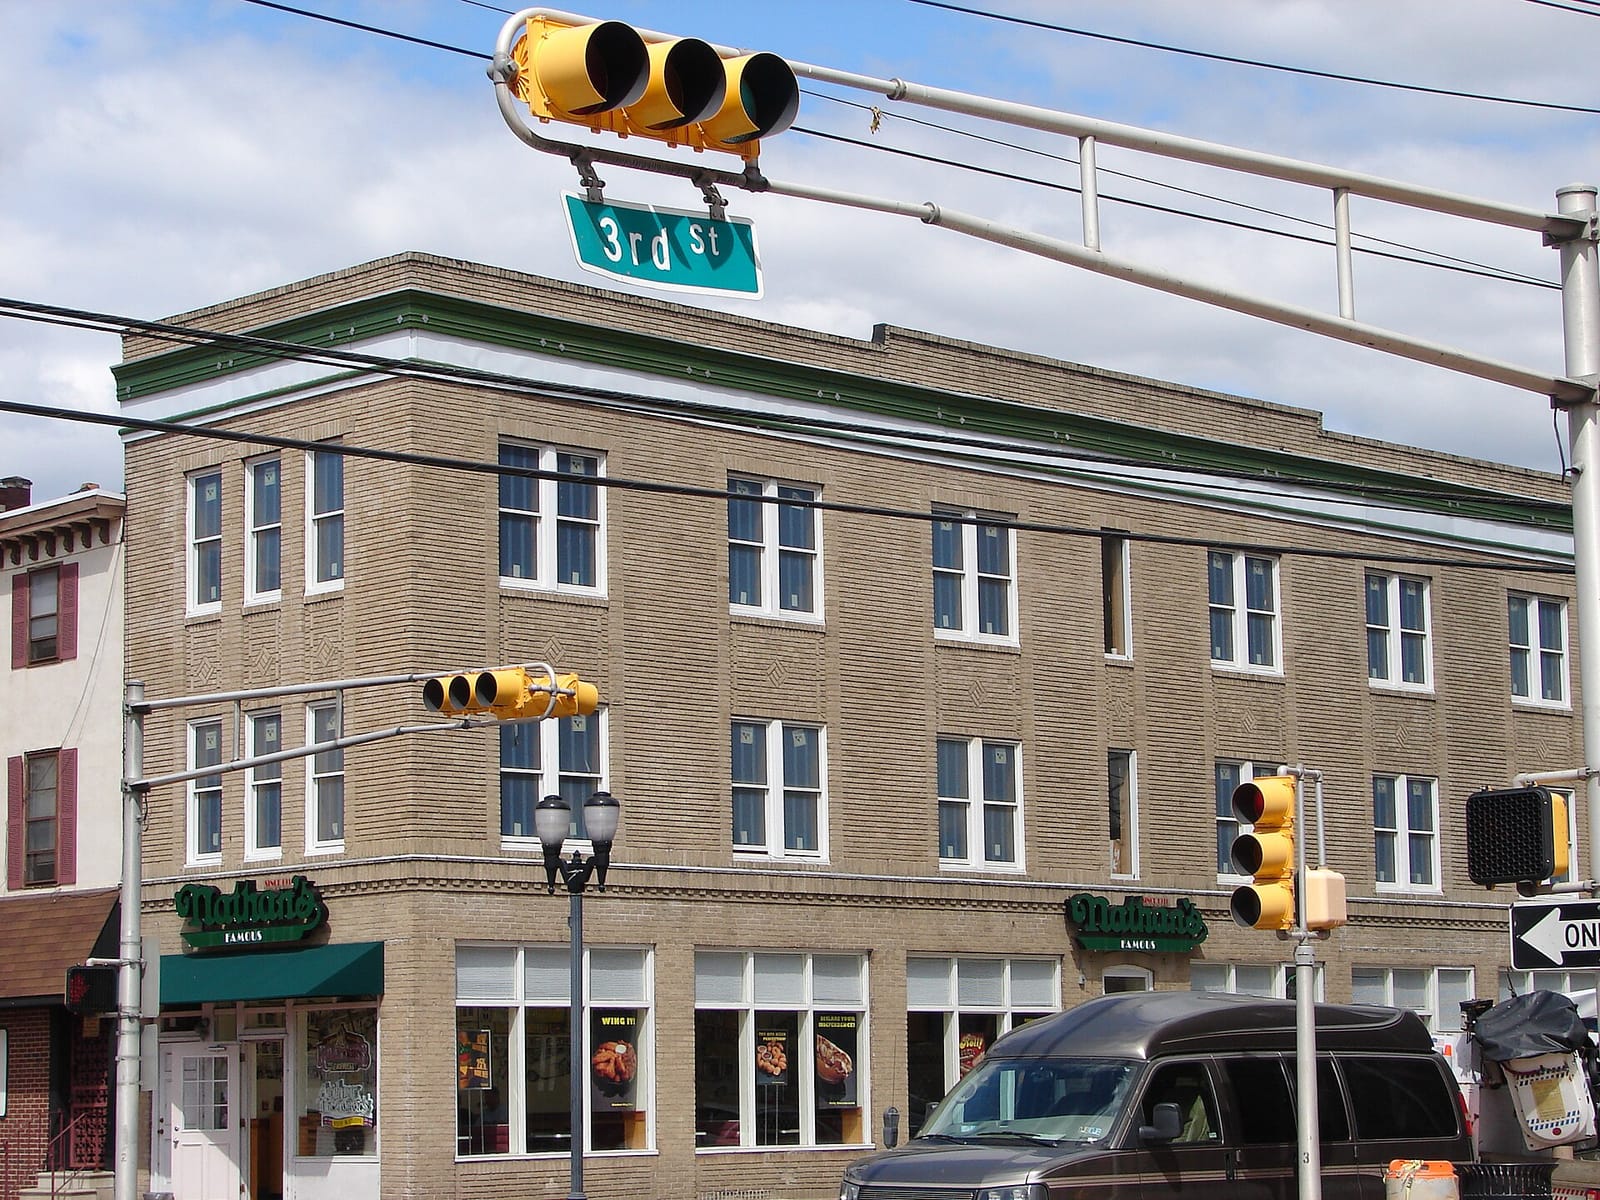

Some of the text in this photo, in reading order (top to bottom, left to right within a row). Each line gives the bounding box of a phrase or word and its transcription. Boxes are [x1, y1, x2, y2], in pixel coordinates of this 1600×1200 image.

[599, 216, 719, 272] 3rd St
[175, 875, 322, 931] Nathan's
[1070, 892, 1209, 944] Nathan's
[224, 930, 263, 943] FAMOUS
[1120, 939, 1156, 950] FAMOUS
[1565, 922, 1600, 948] ON
[601, 1017, 620, 1026] WING
[1303, 1152, 1310, 1164] 3
